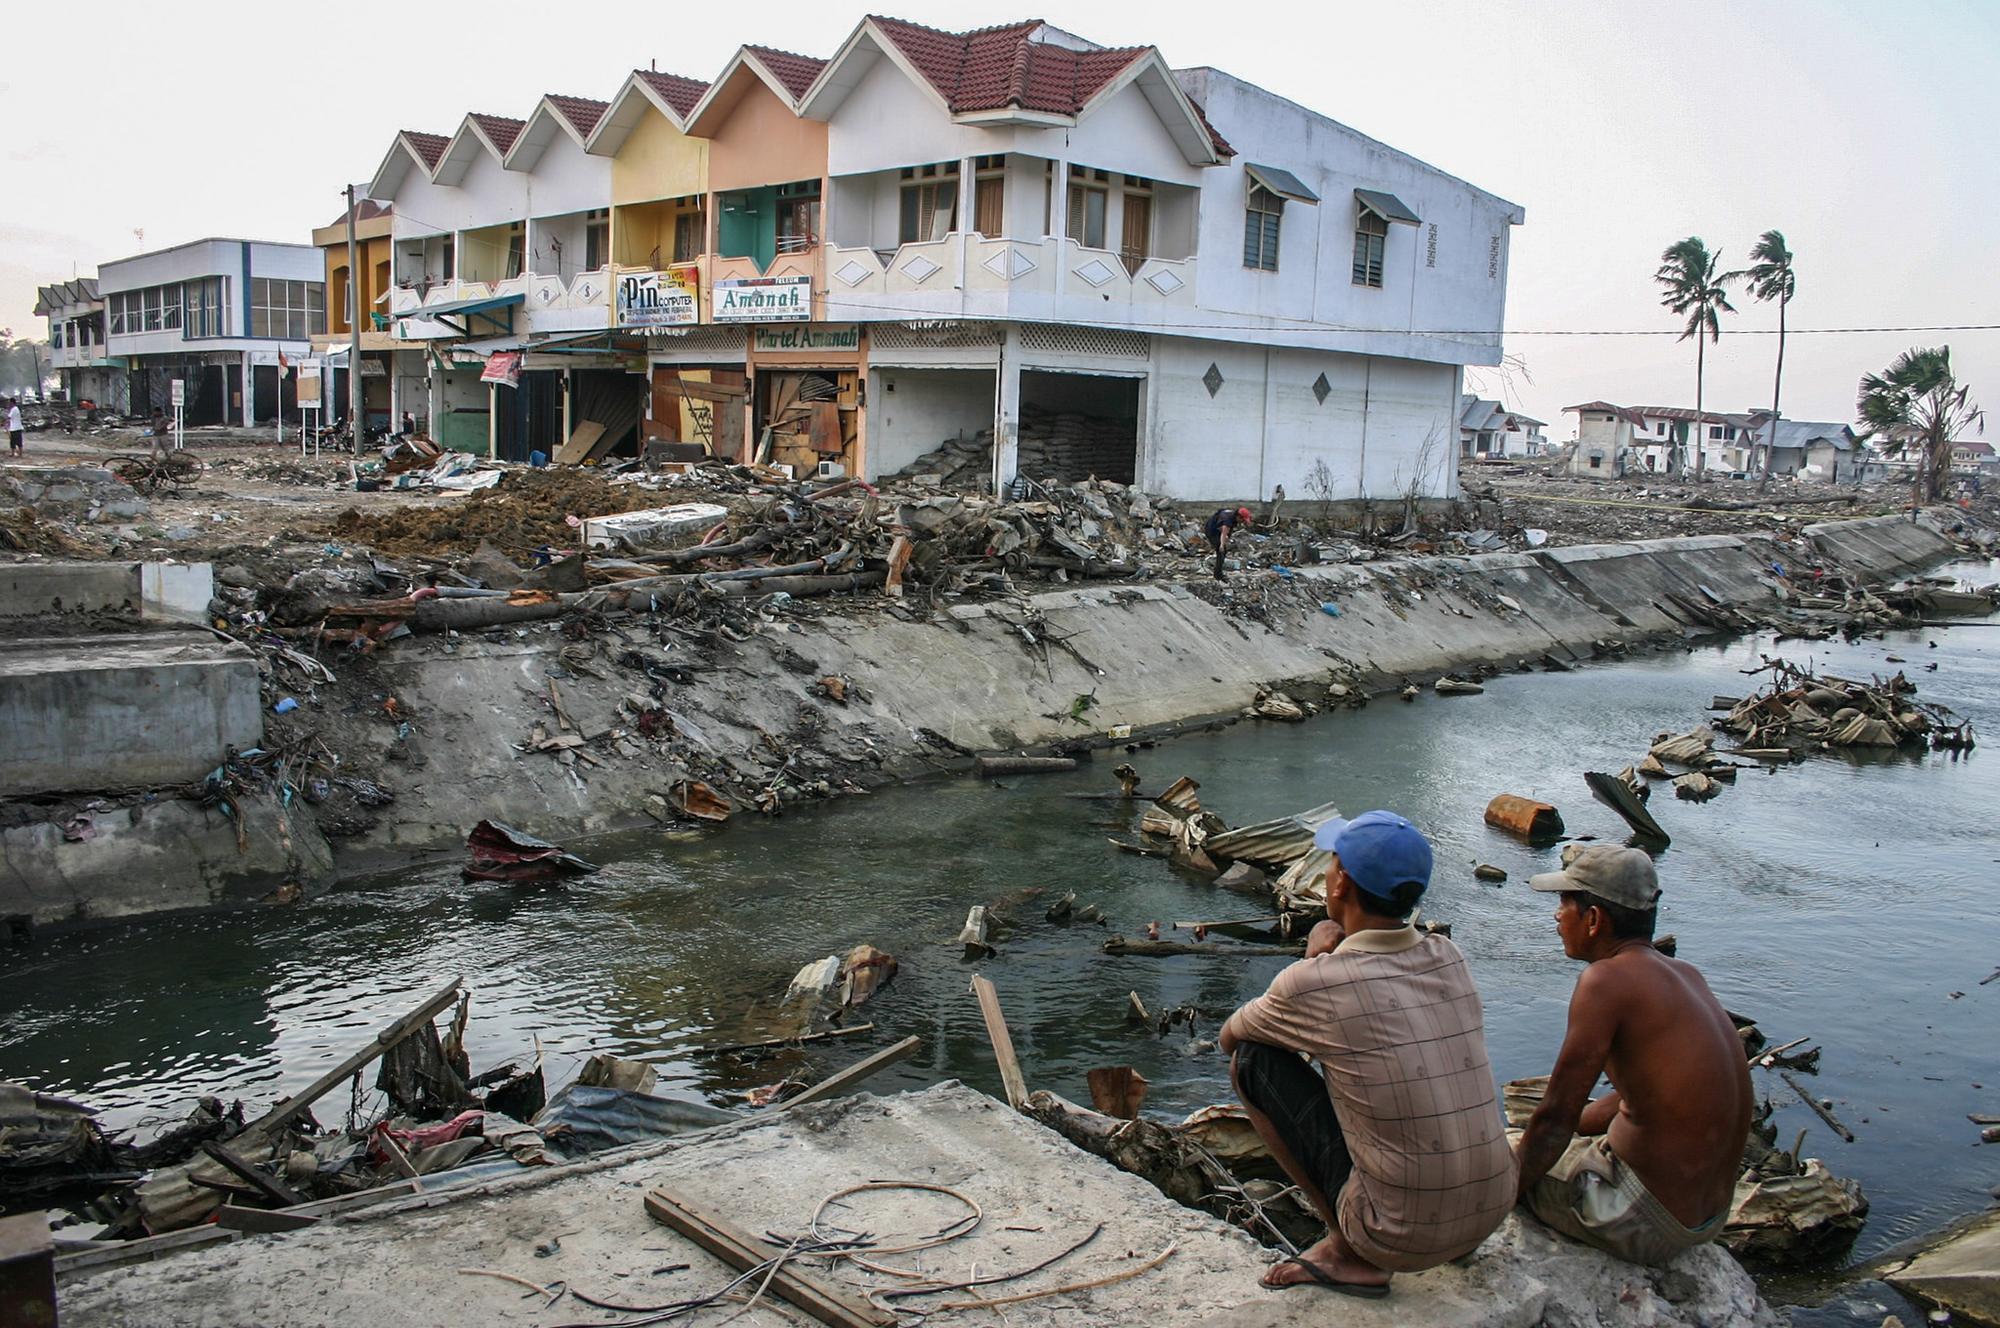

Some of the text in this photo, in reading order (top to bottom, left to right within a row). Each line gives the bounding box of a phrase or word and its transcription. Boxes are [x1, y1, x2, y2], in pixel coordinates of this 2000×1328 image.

[627, 277, 657, 308] Pin
[658, 296, 693, 307] COMPUTER
[723, 287, 799, 308] Amanah
[801, 326, 857, 348] Amanah
